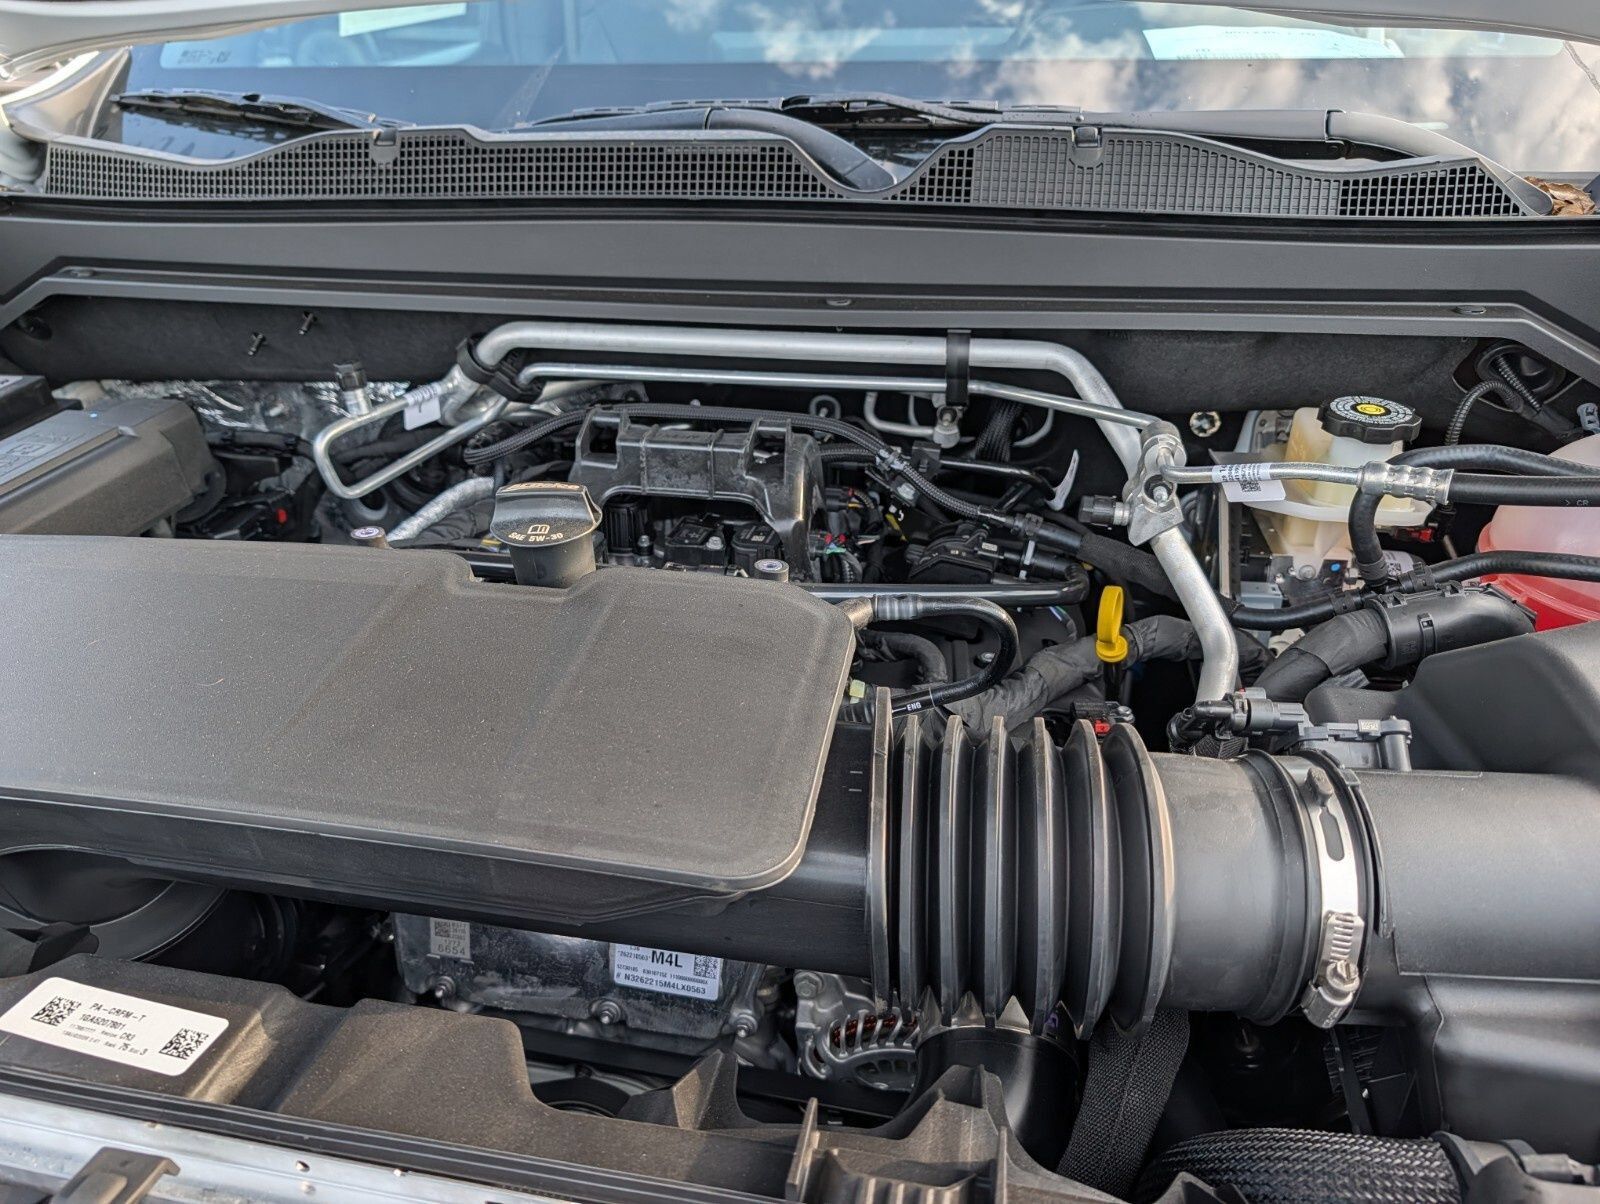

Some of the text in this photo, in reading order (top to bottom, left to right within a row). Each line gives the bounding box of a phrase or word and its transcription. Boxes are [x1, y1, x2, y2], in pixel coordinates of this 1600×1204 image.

[508, 531, 564, 542] SAE 5W-30
[906, 701, 922, 711] ENG
[651, 949, 683, 968] M4L
